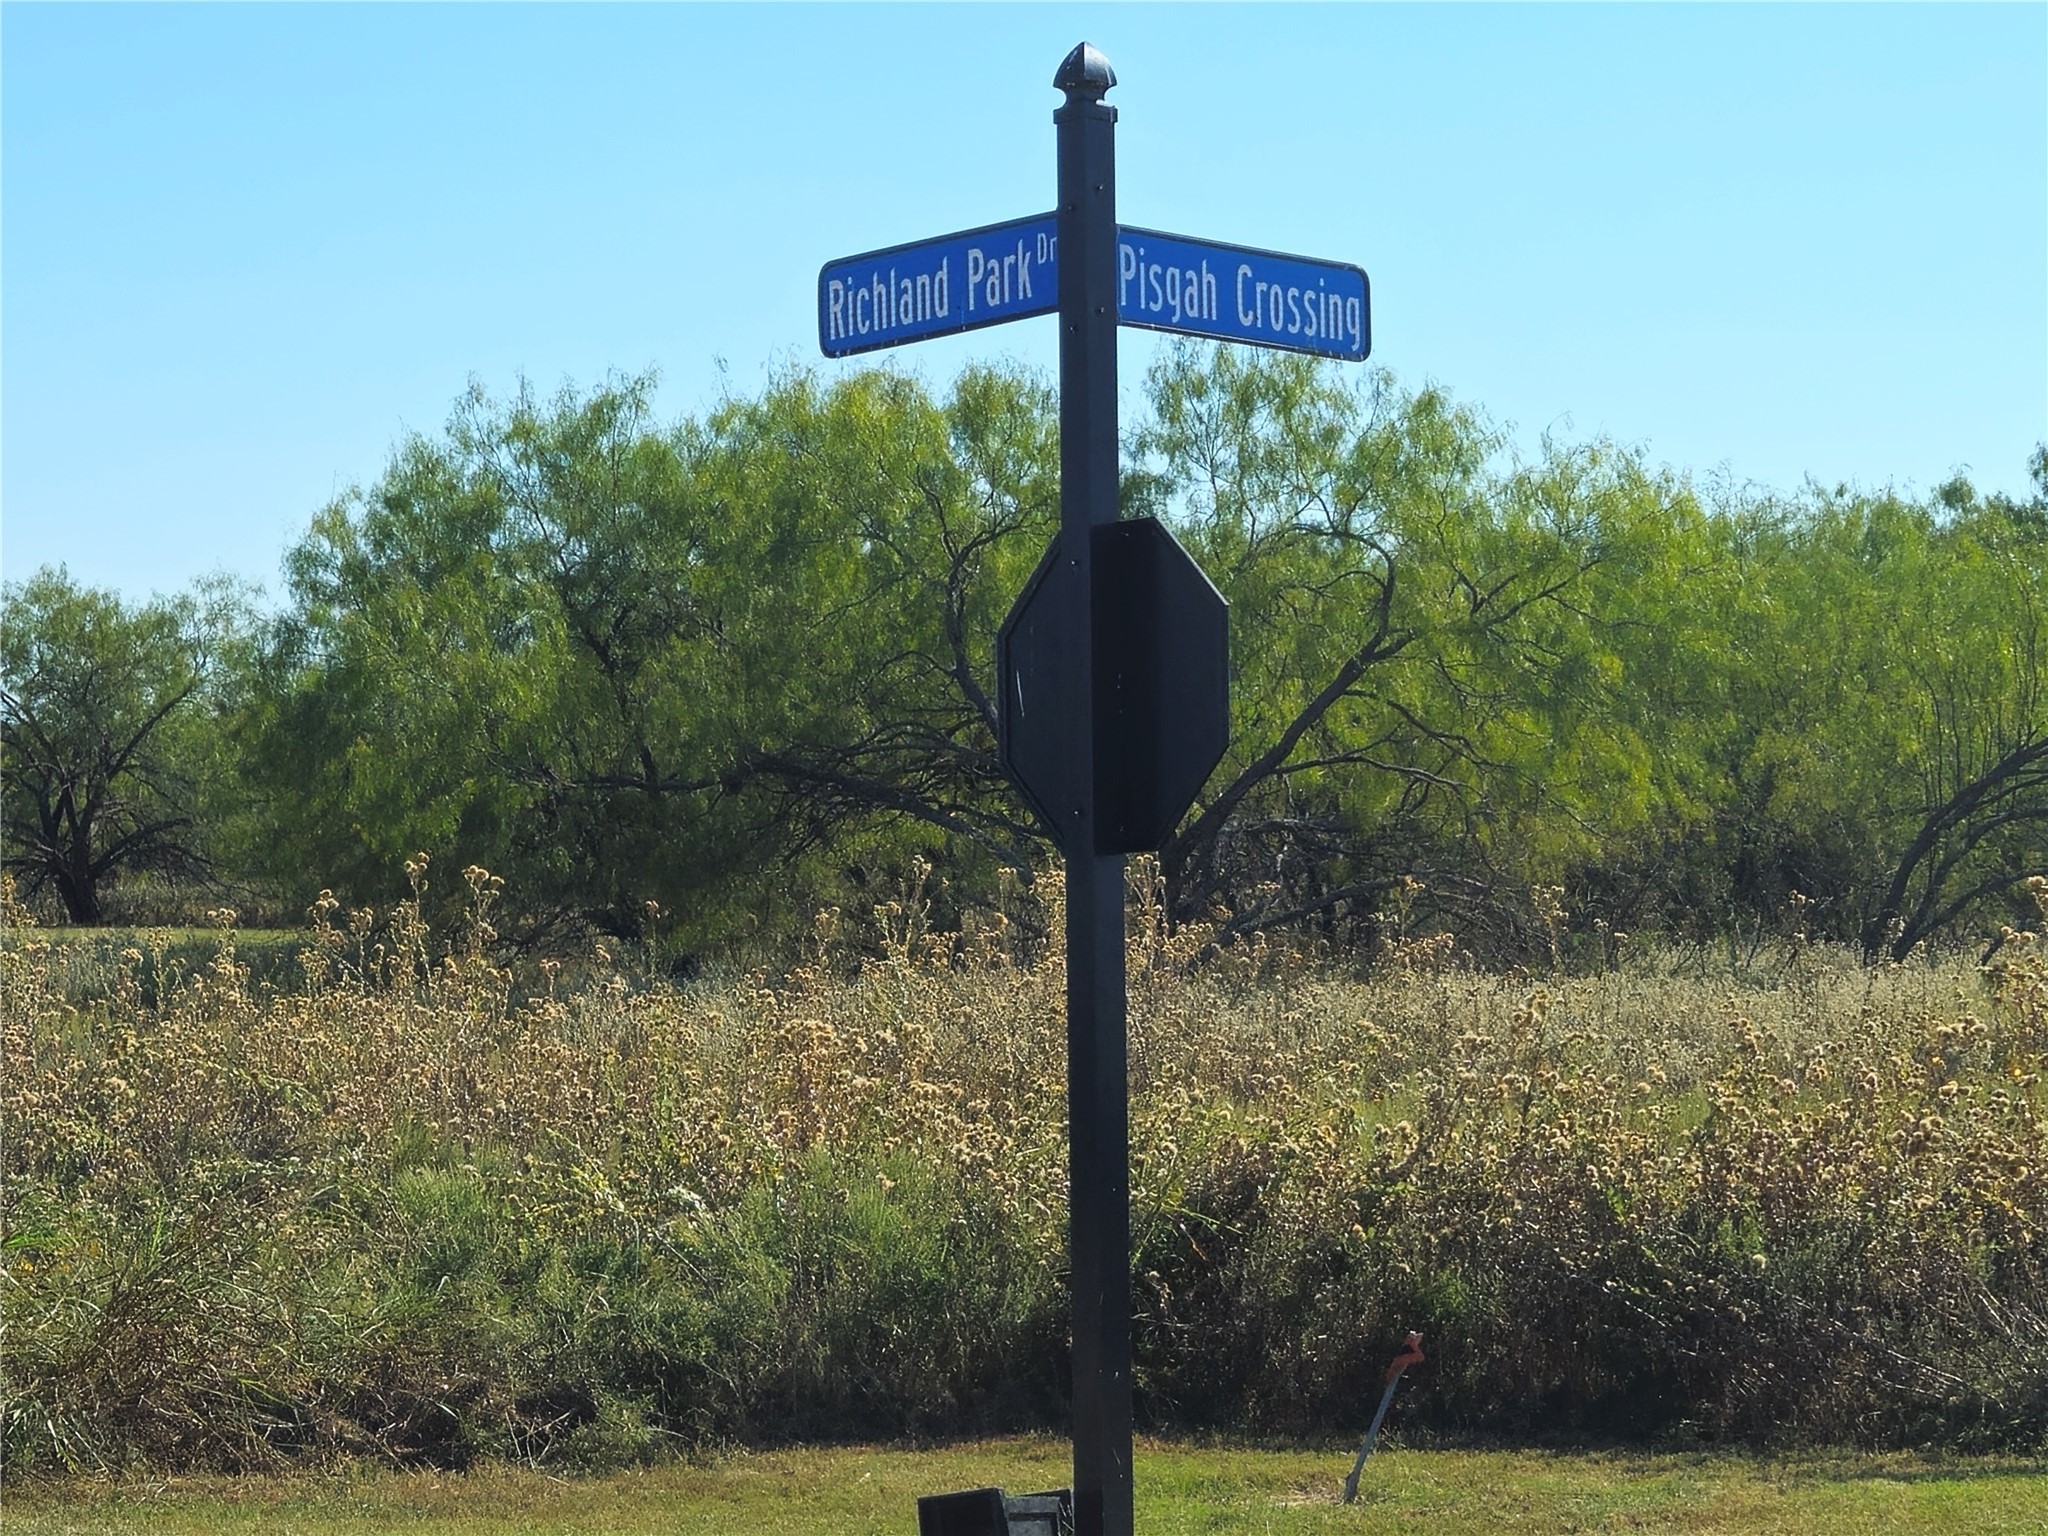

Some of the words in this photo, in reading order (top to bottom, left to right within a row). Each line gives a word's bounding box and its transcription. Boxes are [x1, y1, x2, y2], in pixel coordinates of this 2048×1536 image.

[828, 256, 949, 341] Richland
[968, 238, 1032, 311] Park
[1037, 232, 1057, 265] Dr
[1119, 243, 1217, 324] Pisgah
[1236, 263, 1361, 351] Crossing
